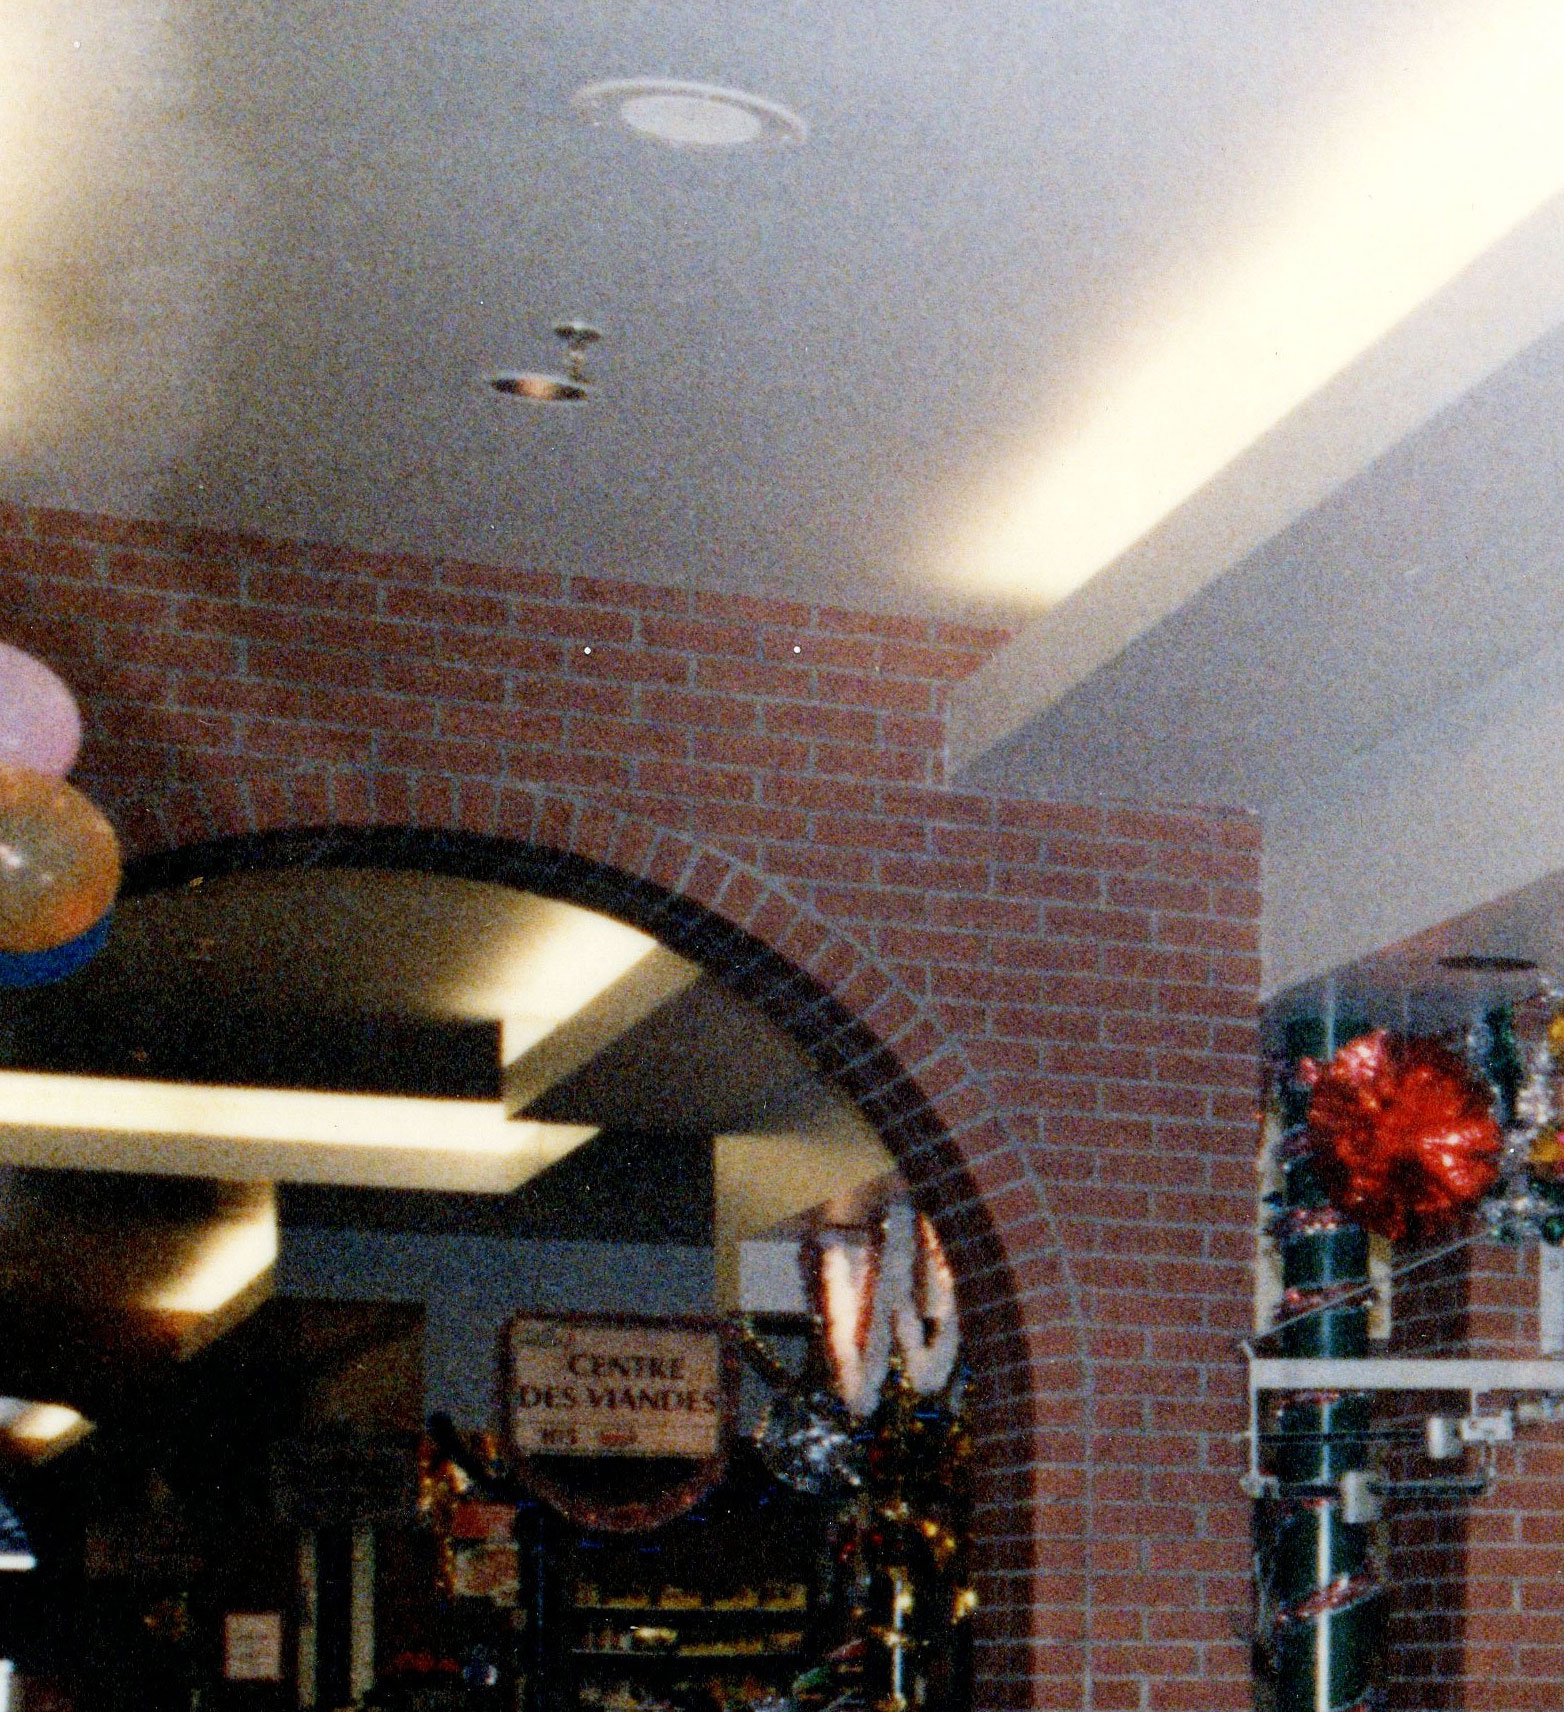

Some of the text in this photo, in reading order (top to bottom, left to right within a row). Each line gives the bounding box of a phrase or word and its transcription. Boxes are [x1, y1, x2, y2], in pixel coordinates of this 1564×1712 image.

[567, 1354, 686, 1381] CENTRE
[517, 1384, 716, 1414] DES VIANDES
